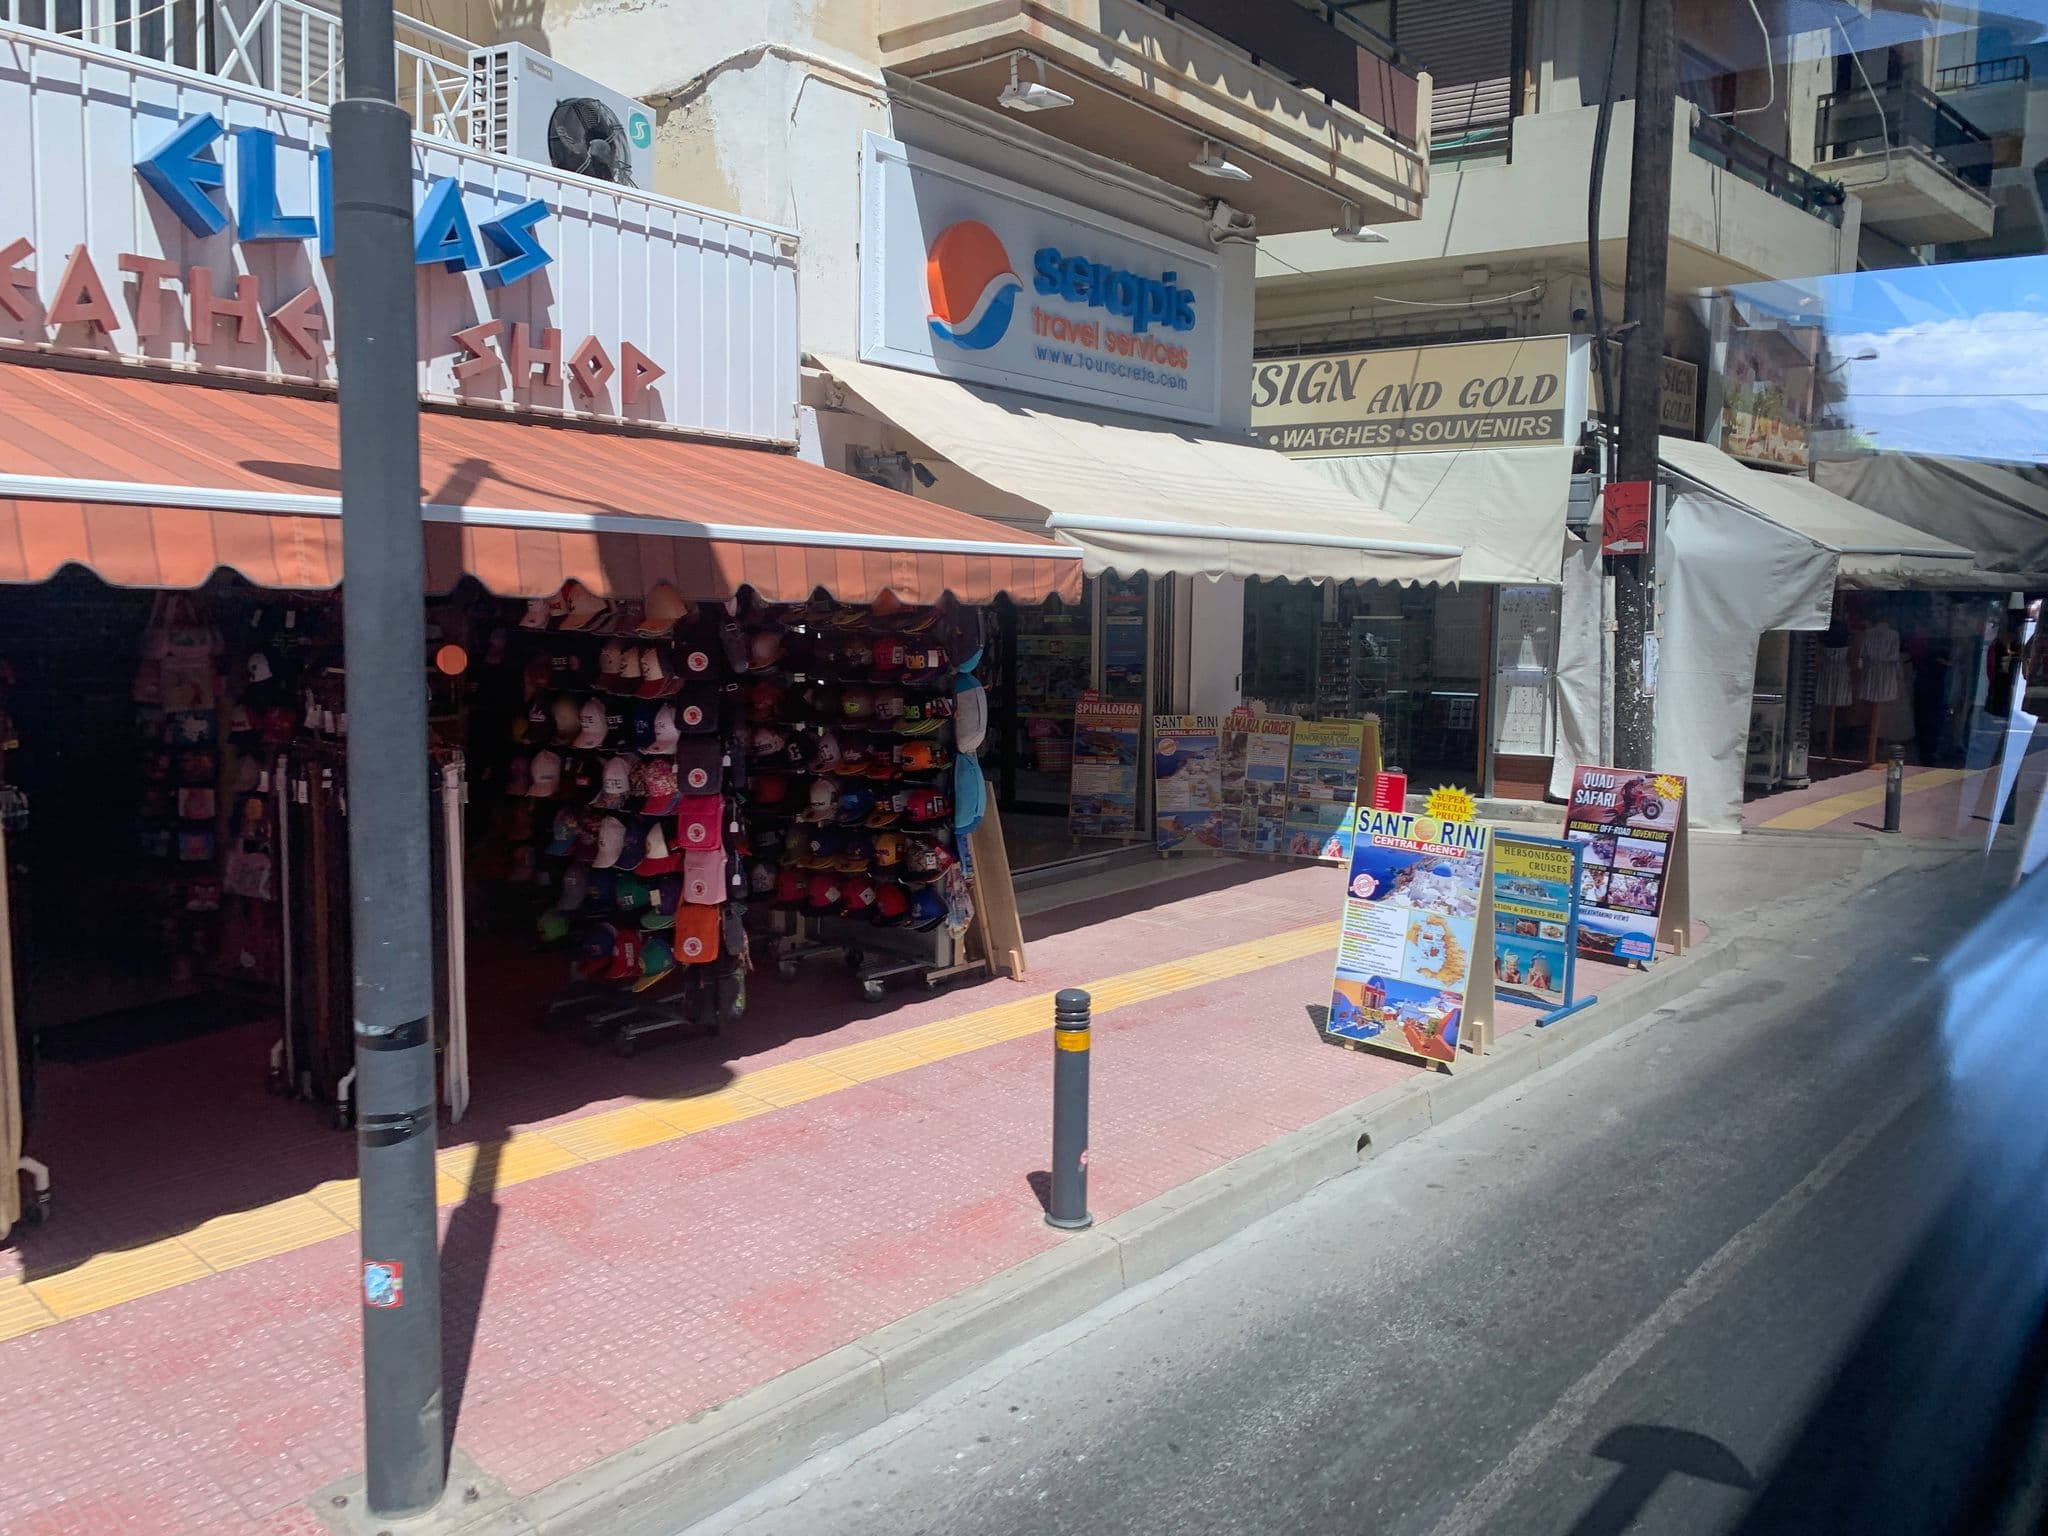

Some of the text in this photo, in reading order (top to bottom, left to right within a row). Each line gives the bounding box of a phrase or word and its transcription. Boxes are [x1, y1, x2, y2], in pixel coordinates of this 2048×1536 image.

[1033, 247, 1196, 333] serapis
[1032, 306, 1189, 370] travel services
[452, 320, 666, 403] SHOP
[1251, 358, 1558, 414] SIGN AND GOLD
[1283, 415, 1553, 449] WATCHES SOUVENIRS
[1077, 703, 1139, 715] SPINALONGA
[1583, 772, 1615, 789] QUAD
[1436, 793, 1467, 804] SUPER
[1575, 789, 1617, 807] SAFARI
[1431, 802, 1469, 814] SPECIAL
[1435, 812, 1463, 822] PRICE
[1631, 830, 1669, 841] ADVENTURE
[1374, 836, 1465, 857] CENTRAL AGENCY
[1504, 847, 1568, 863] HERSONISSOS
[1529, 861, 1567, 874] CRUISES
